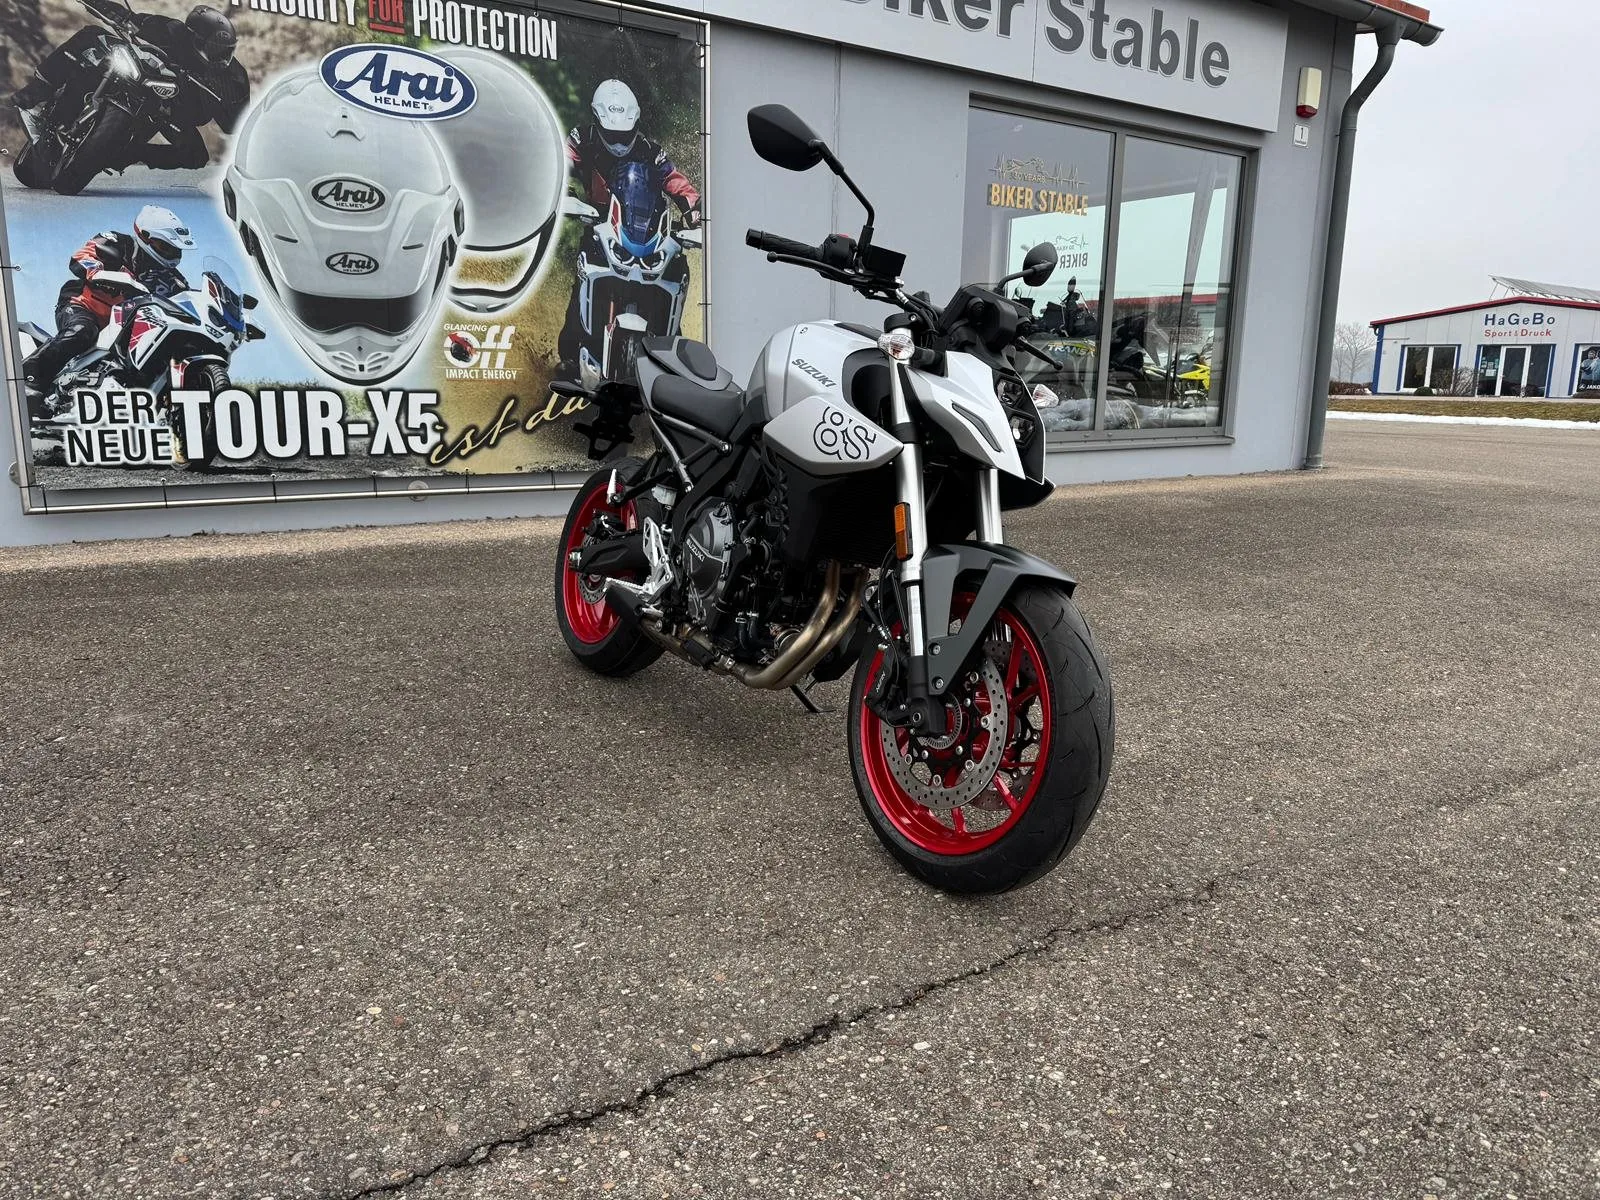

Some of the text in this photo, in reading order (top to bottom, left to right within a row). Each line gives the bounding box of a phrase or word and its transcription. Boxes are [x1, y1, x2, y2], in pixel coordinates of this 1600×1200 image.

[412, 0, 558, 60] PROTECTION
[1045, 0, 1230, 87] Stable
[334, 53, 459, 102] Arai
[374, 95, 430, 110] HELMET
[318, 182, 377, 205] Arai
[991, 183, 1089, 216] BIKER STABLE
[330, 254, 374, 269] Arai
[443, 323, 488, 332] GLANCING
[1484, 312, 1555, 326] HaGeBo
[1484, 329, 1512, 338] Sport
[1520, 329, 1552, 337] Druck
[445, 368, 518, 380] IMPACT ENERGY
[791, 358, 837, 388] SUZUKI
[77, 390, 156, 425] DER
[171, 390, 440, 459] TOUR-X5
[430, 399, 517, 464] ist
[67, 428, 172, 463] NEUE
